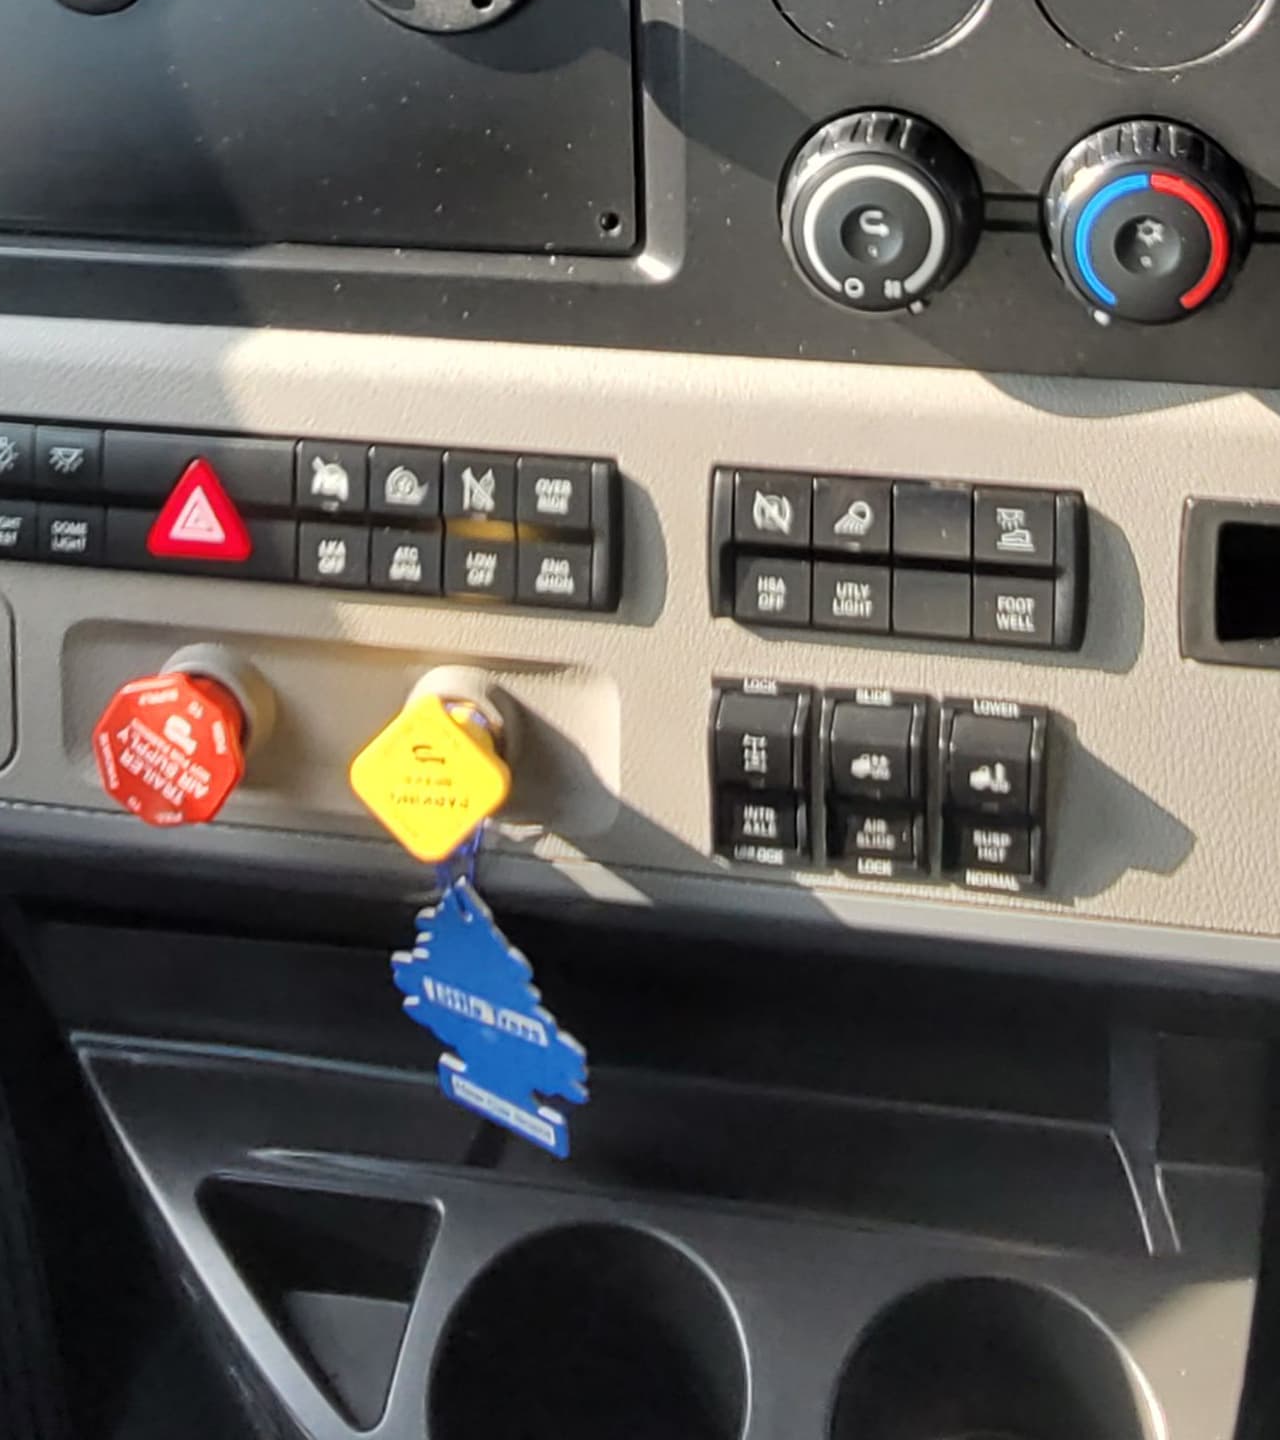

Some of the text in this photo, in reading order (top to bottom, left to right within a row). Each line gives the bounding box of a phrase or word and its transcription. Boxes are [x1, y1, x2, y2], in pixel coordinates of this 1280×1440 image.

[535, 477, 572, 496] OVER
[52, 520, 88, 536] DOME
[51, 535, 86, 552] LIGHT
[318, 557, 345, 574] OFF
[467, 568, 494, 586] OFF
[758, 593, 785, 611] OFF
[832, 598, 872, 618] LIGHT
[997, 595, 1035, 615] FOOT
[996, 613, 1036, 633] WELL
[743, 678, 778, 696] LOCK
[973, 698, 1020, 718] LOWER
[116, 724, 180, 779] SUPPLY
[120, 747, 186, 806] TRAILER
[177, 770, 210, 799] AIR
[863, 817, 888, 833] AIR
[857, 857, 893, 877] LOCK
[965, 868, 1020, 892] NORMAL
